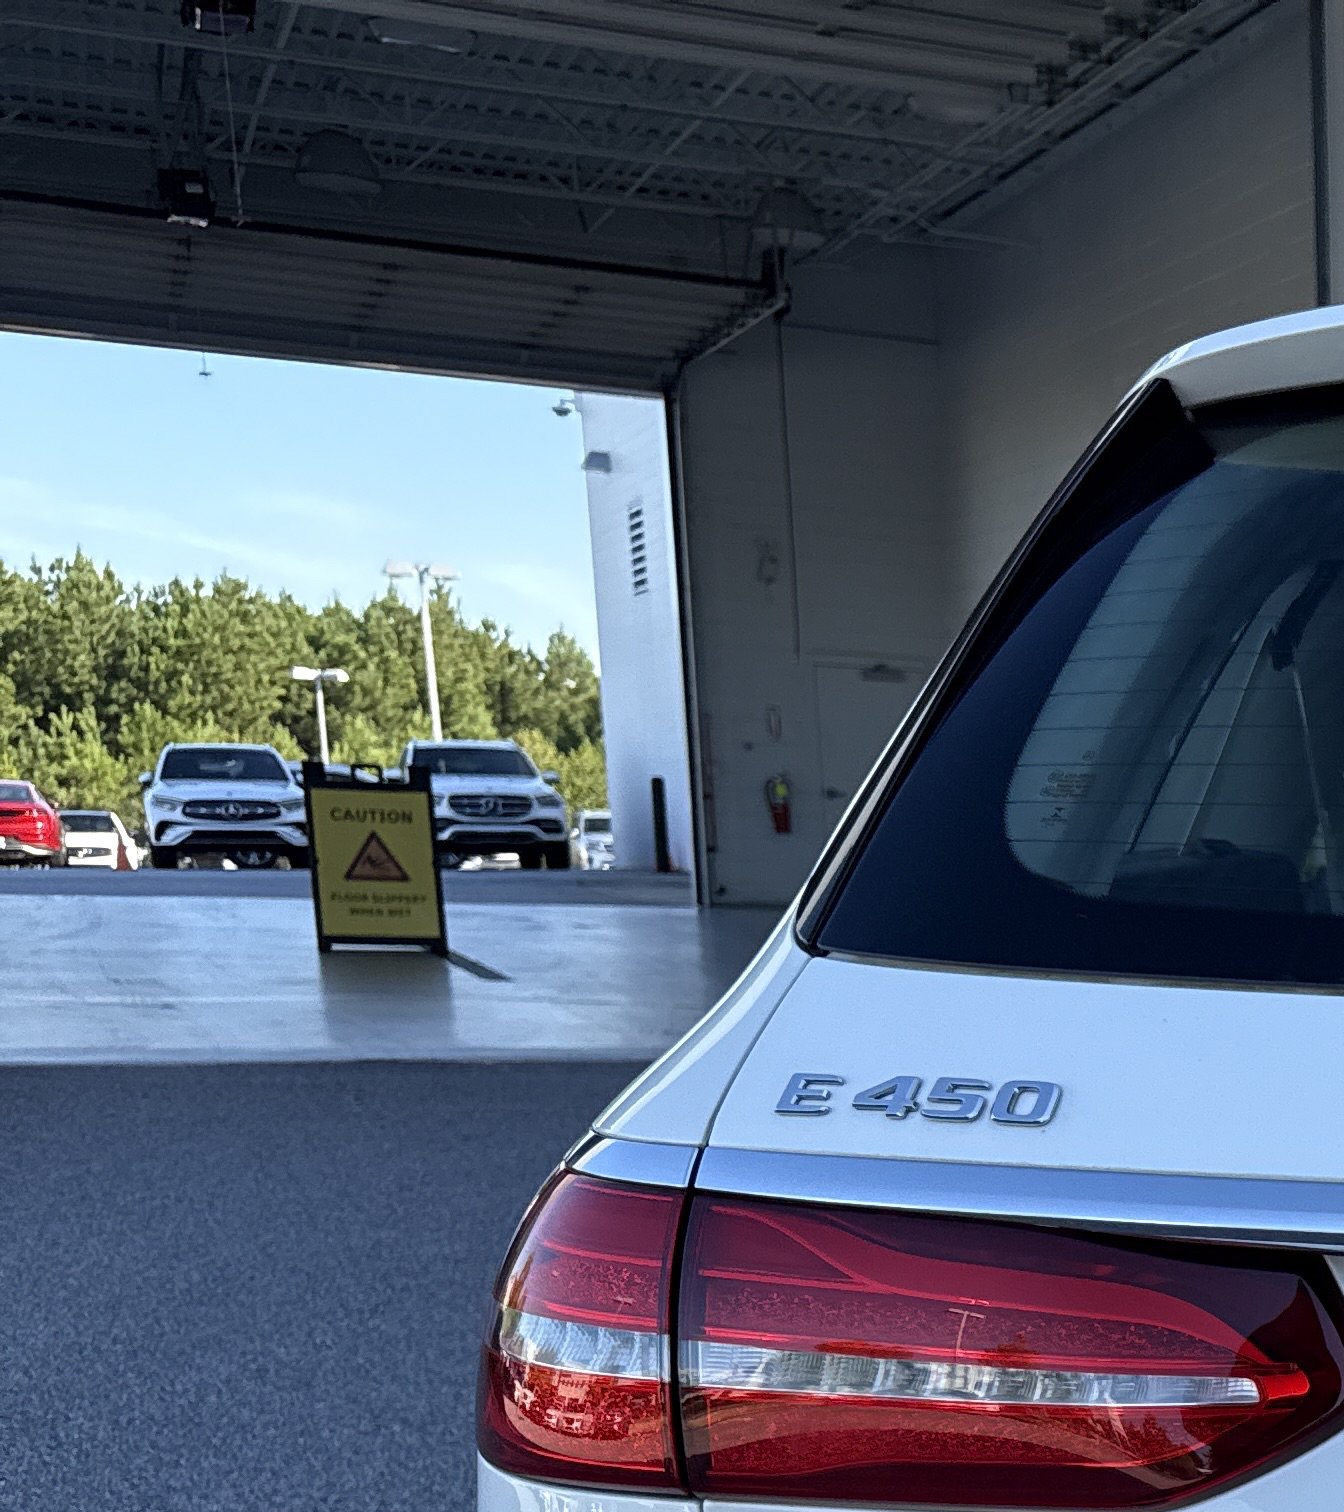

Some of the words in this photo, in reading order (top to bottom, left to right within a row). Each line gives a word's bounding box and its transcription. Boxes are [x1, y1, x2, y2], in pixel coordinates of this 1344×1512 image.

[329, 806, 413, 824] CAUTION
[774, 1072, 847, 1116] E
[852, 1075, 1064, 1128] 450
